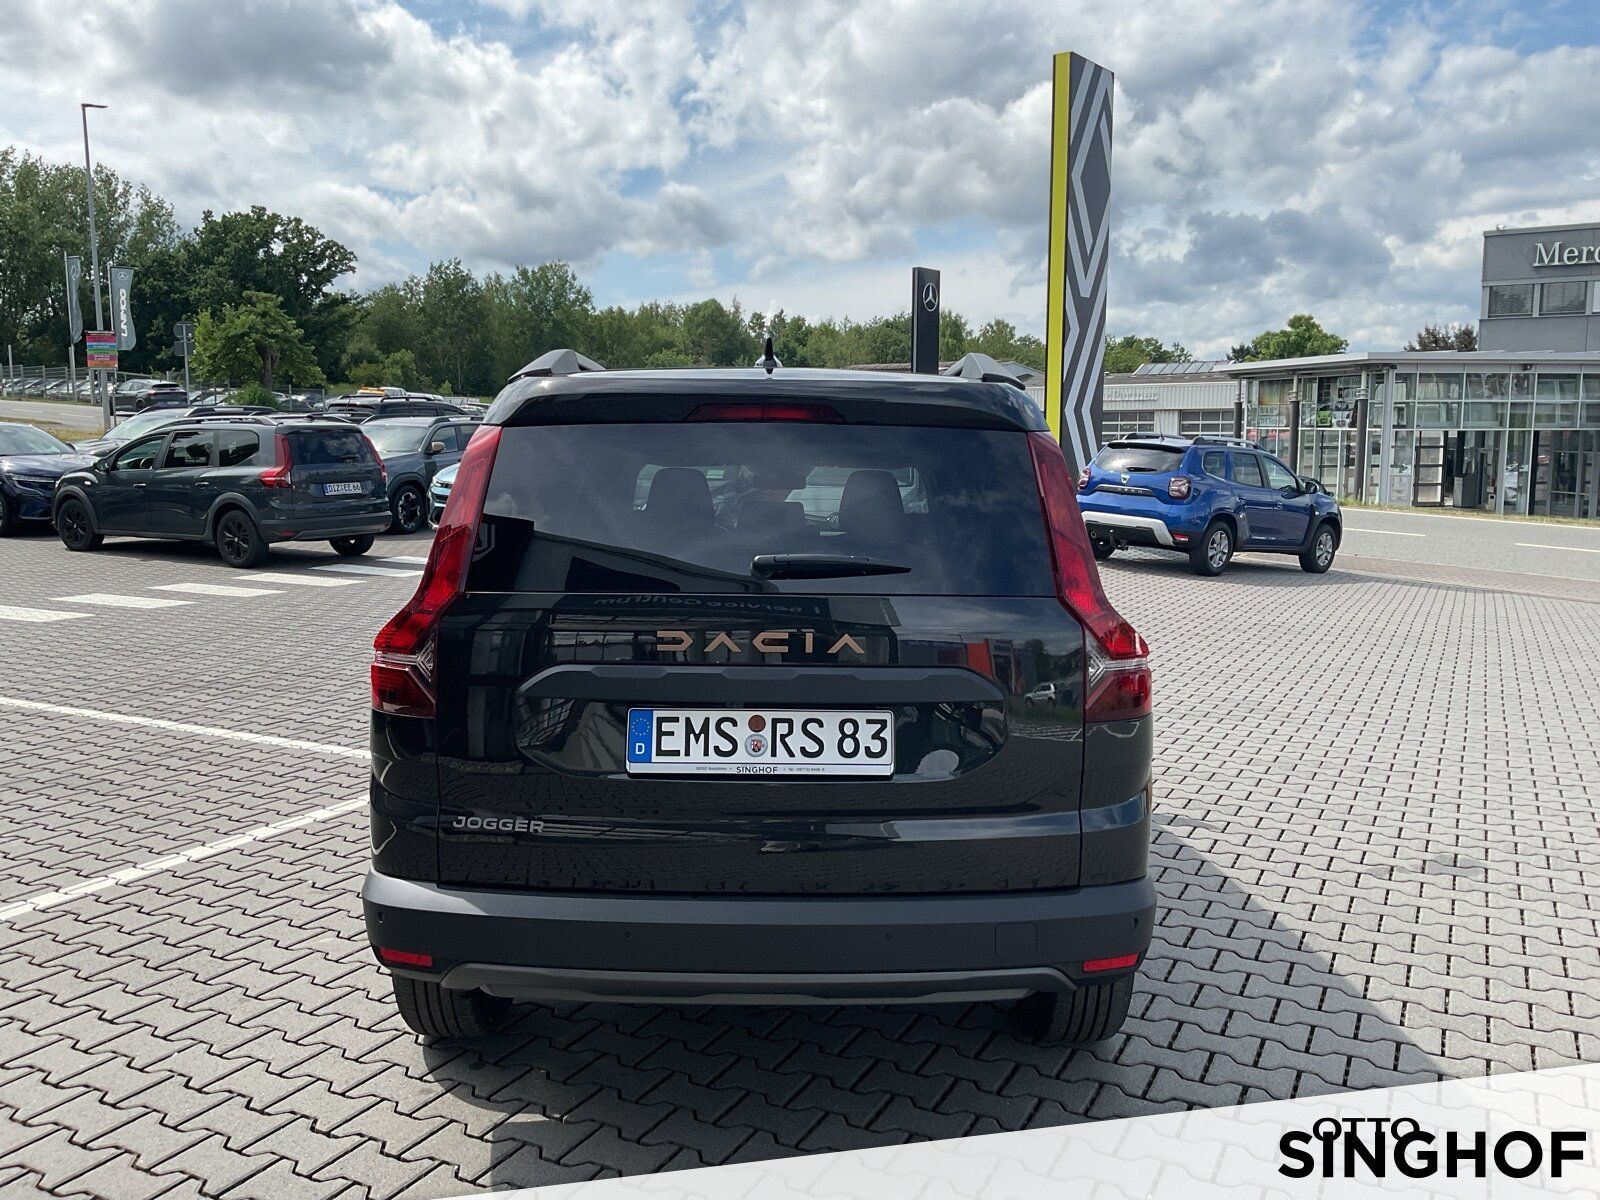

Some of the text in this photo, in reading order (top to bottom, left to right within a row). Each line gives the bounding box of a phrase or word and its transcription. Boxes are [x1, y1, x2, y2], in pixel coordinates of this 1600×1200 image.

[119, 288, 128, 337] UNIMOG
[328, 484, 340, 493] DIZ
[656, 629, 866, 655] DACIA
[635, 716, 888, 759] D EMS RS 83
[735, 766, 778, 774] SINGHOF
[452, 816, 545, 833] JOGGER
